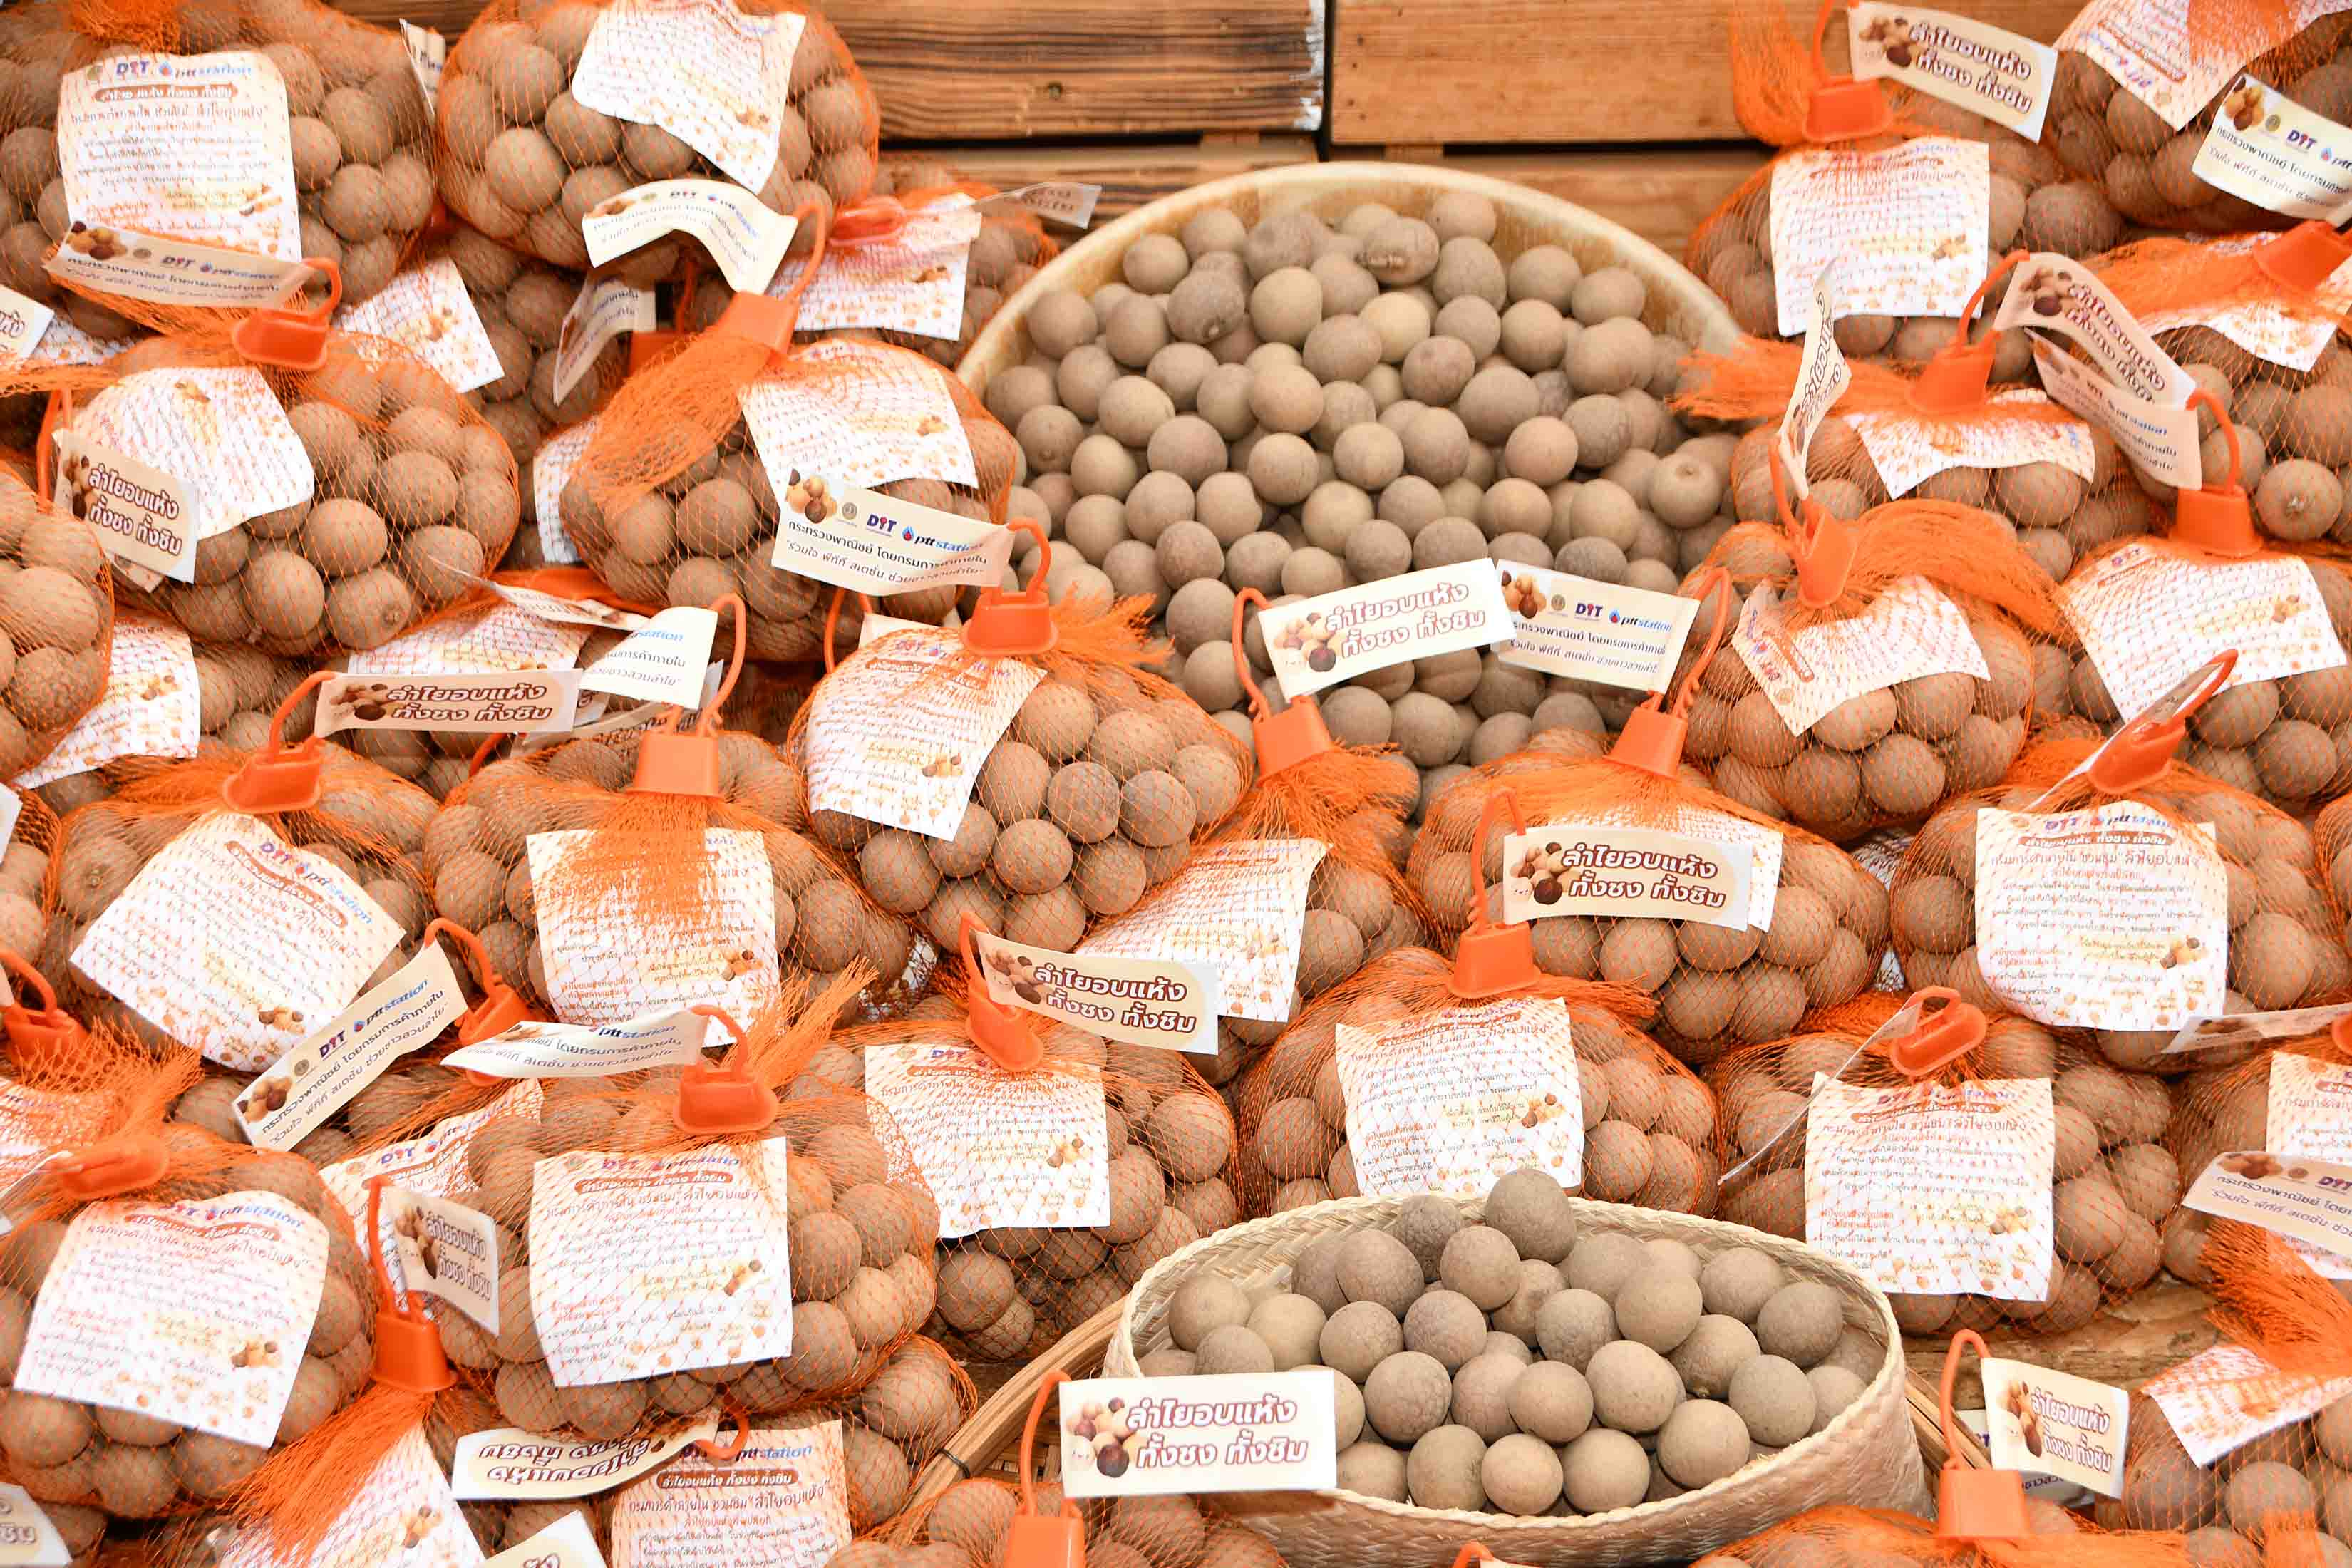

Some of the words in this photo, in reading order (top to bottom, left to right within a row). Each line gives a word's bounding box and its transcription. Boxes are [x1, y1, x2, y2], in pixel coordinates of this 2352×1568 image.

[88, 463, 180, 520] ลำไยอบแห้ง
[88, 496, 135, 536] ทั้งชง
[136, 518, 183, 557] ทั้งชิม
[789, 519, 873, 555] กระทรวงพาณิชย์
[867, 513, 897, 532] DIT
[1324, 582, 1469, 634] ลำไยอบแห้ง
[1575, 600, 1604, 619] DIT
[1341, 626, 1410, 659] ทั้งชง
[1415, 607, 1487, 639] ทั้งชิม
[387, 684, 547, 703] ลำไยอบแห้ง
[391, 704, 470, 721] ทั้งชง
[474, 704, 553, 722] ทั้งชิม
[1562, 842, 1718, 880] ลำไยอบแห้ง
[1569, 870, 1644, 899] ทั้งชง
[1650, 875, 1726, 909] ทั้งชิม
[1034, 962, 1187, 1002] ลำไยอบแห้ง
[1046, 989, 1115, 1023] ทั้งชง
[1120, 1001, 1197, 1034] ทั้งชิม
[262, 1061, 342, 1134] กระทรวงพาณิชย์
[342, 989, 445, 1066] โดยกรมการค้าภายใน
[319, 1030, 346, 1060] DIT
[2217, 1174, 2321, 1207] กระทรวงพาณิชย์
[1125, 1393, 1297, 1430] ลำไยอบแห้ง
[478, 1443, 564, 1467] ทั้งชิม
[487, 1438, 650, 1485] ลำไยอบแห้ง
[1136, 1432, 1217, 1469] ทั้งชง
[1224, 1429, 1309, 1465] ทั้งชิม
